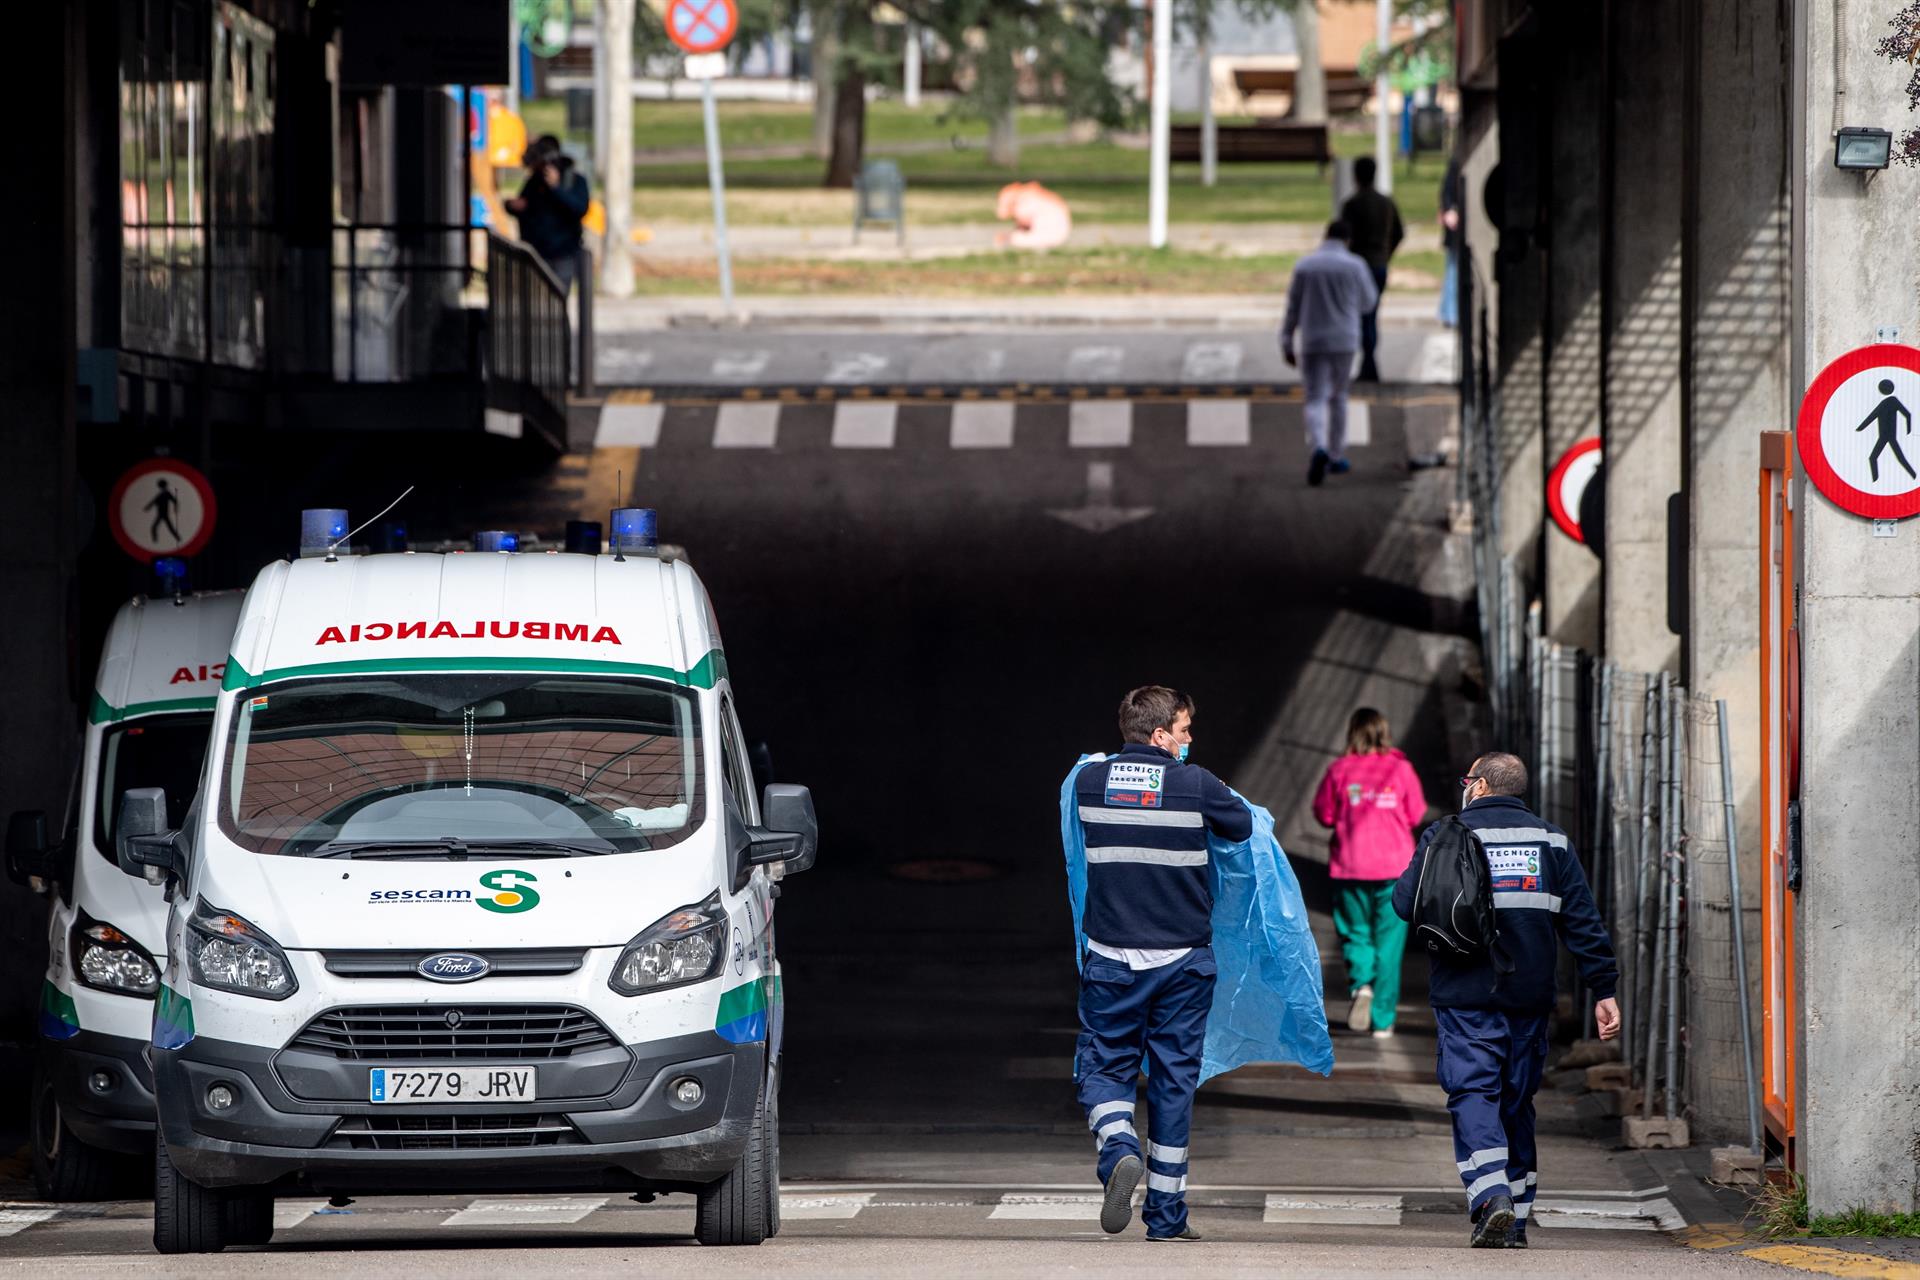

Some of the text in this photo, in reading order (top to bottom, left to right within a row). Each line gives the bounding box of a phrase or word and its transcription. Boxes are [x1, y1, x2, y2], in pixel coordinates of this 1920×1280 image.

[1113, 765, 1161, 775] TECNICO
[370, 889, 471, 900] sescam
[433, 957, 473, 974] Ford
[391, 1072, 529, 1098] 7279 JRV
